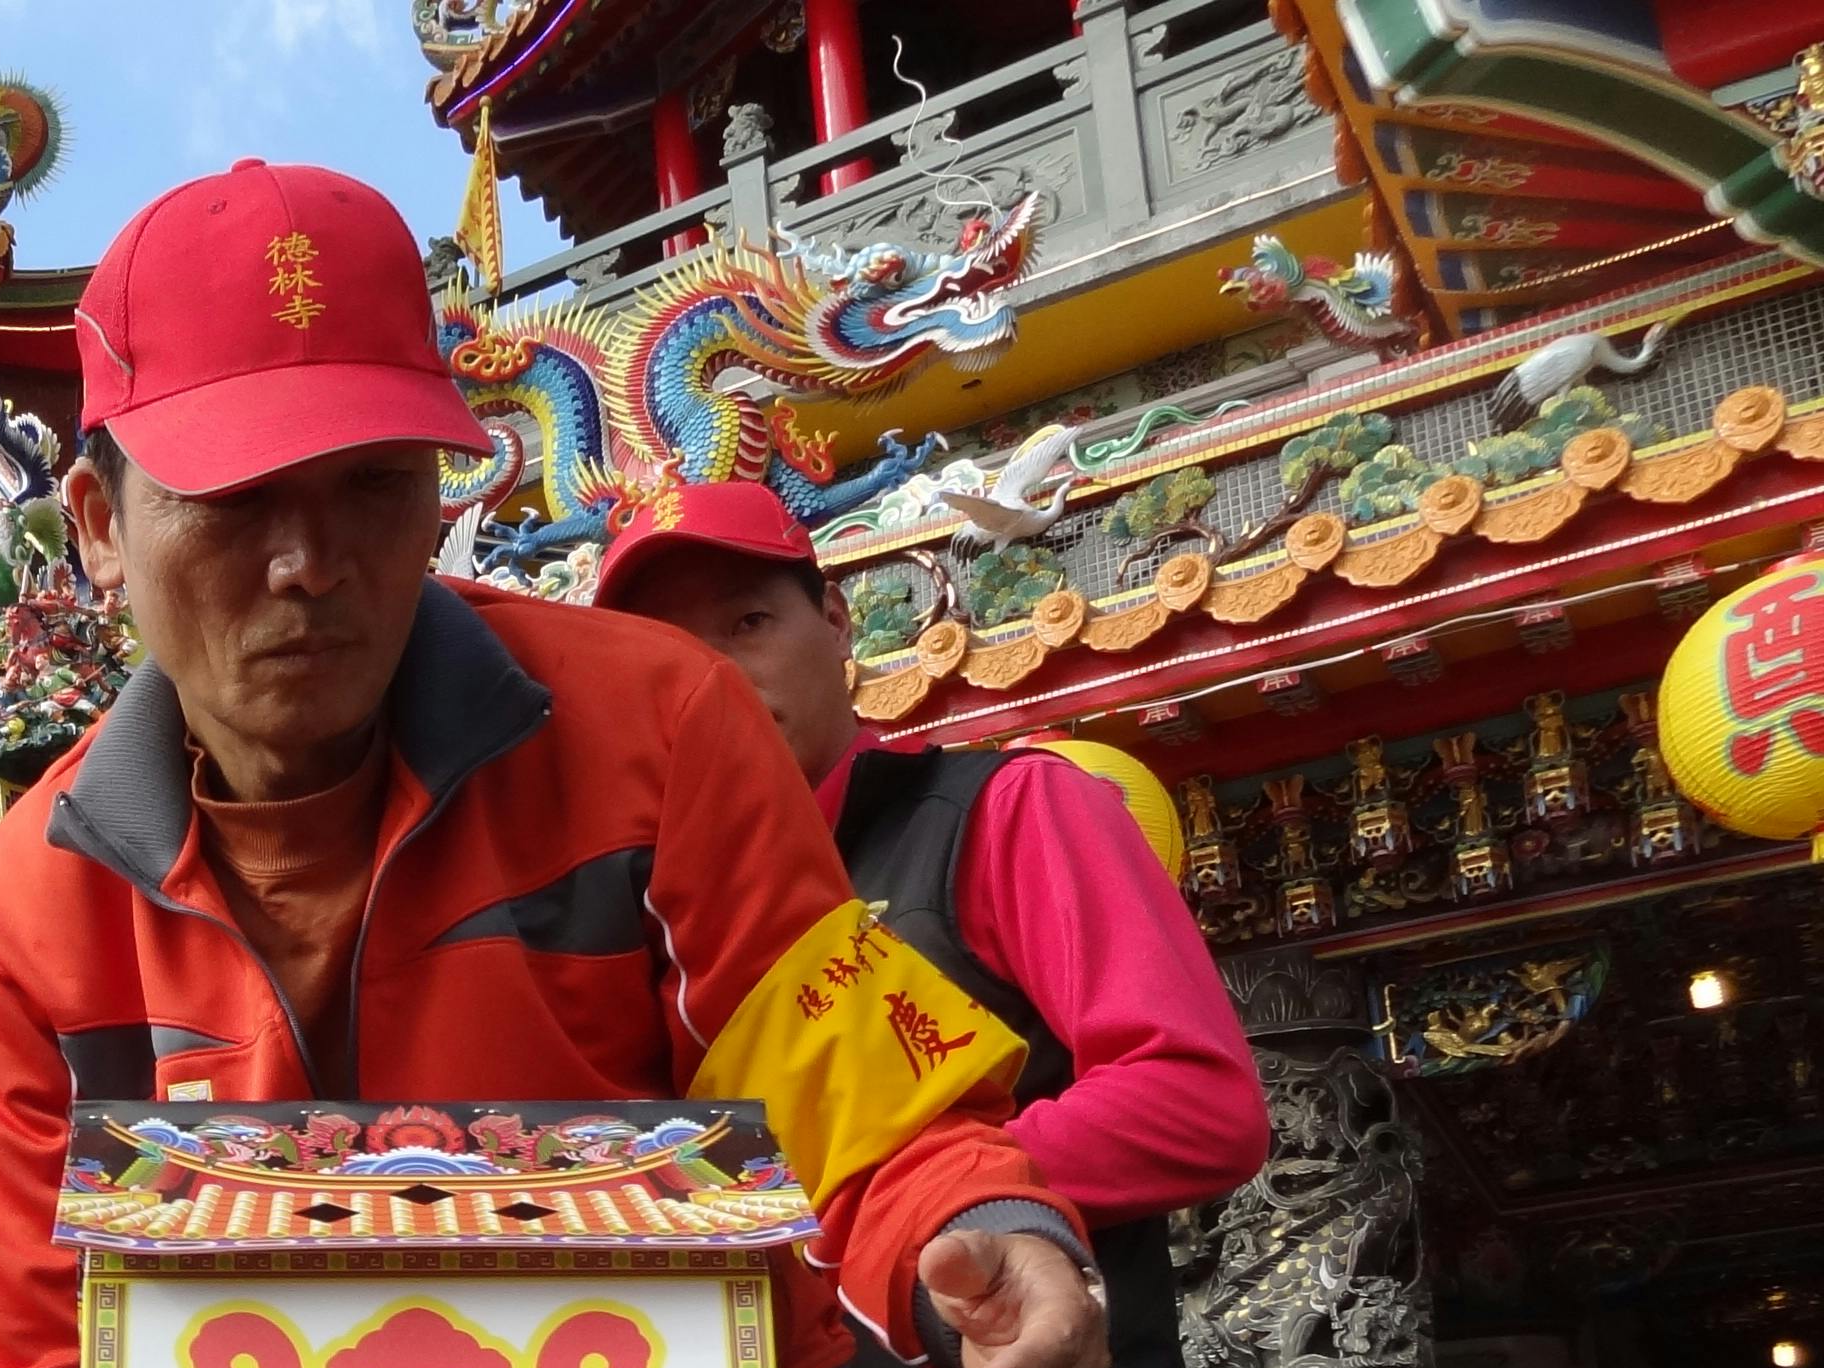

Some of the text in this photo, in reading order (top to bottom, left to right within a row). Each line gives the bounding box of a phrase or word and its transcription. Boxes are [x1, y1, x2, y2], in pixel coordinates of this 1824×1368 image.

[264, 231, 327, 330] 德林寺
[883, 990, 988, 1082] 慶
